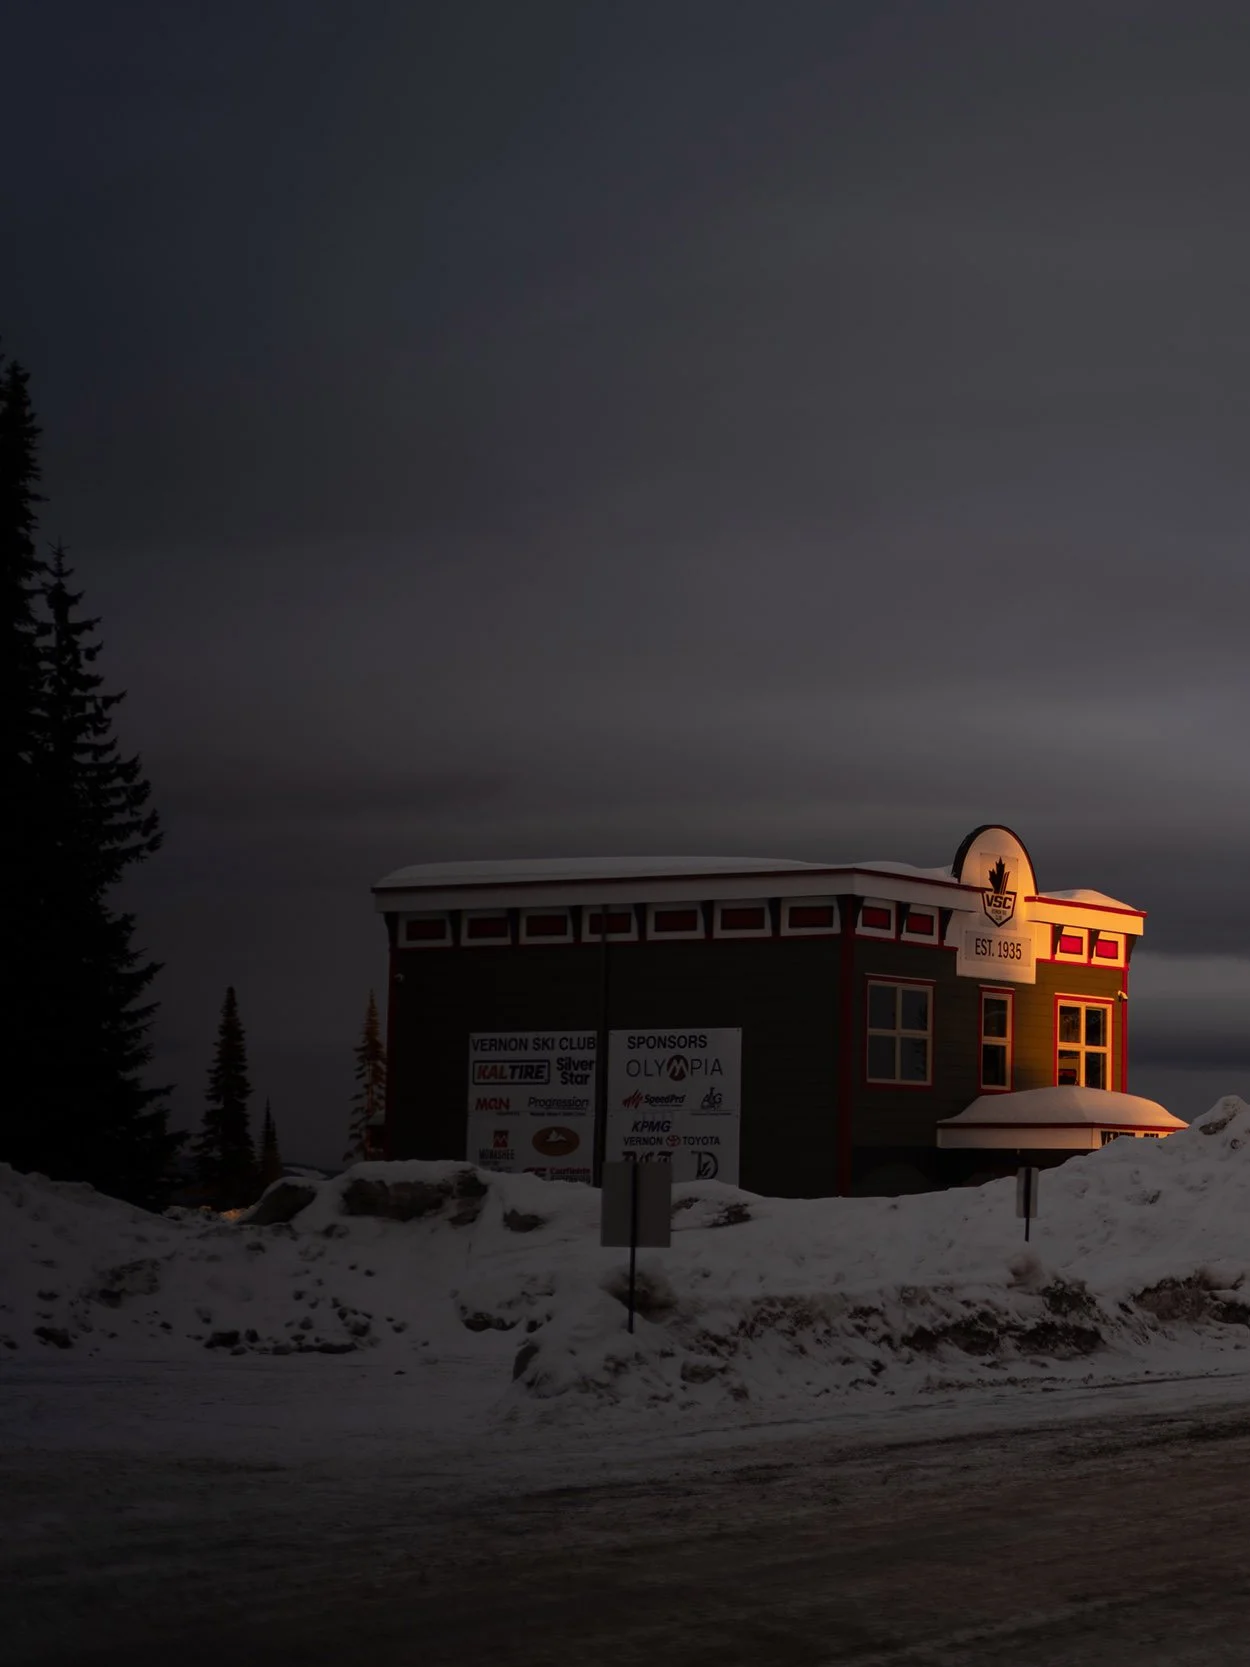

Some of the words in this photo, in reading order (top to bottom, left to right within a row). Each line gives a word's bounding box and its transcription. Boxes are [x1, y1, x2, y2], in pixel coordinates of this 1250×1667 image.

[986, 893, 1012, 909] VSC
[975, 937, 995, 957] EST.
[998, 942, 1022, 960] 1935
[472, 1038, 528, 1051] VERNON
[532, 1037, 555, 1051] SKI
[559, 1037, 596, 1050] CLUB
[627, 1035, 708, 1049] SPONSORS
[556, 1056, 595, 1071] Silver
[626, 1054, 724, 1081] OLYMPIA
[560, 1071, 591, 1085] Star
[528, 1096, 589, 1108] Progression
[631, 1120, 671, 1132] KPMG
[623, 1136, 663, 1146] VERNON
[683, 1136, 721, 1145] TOYOTA
